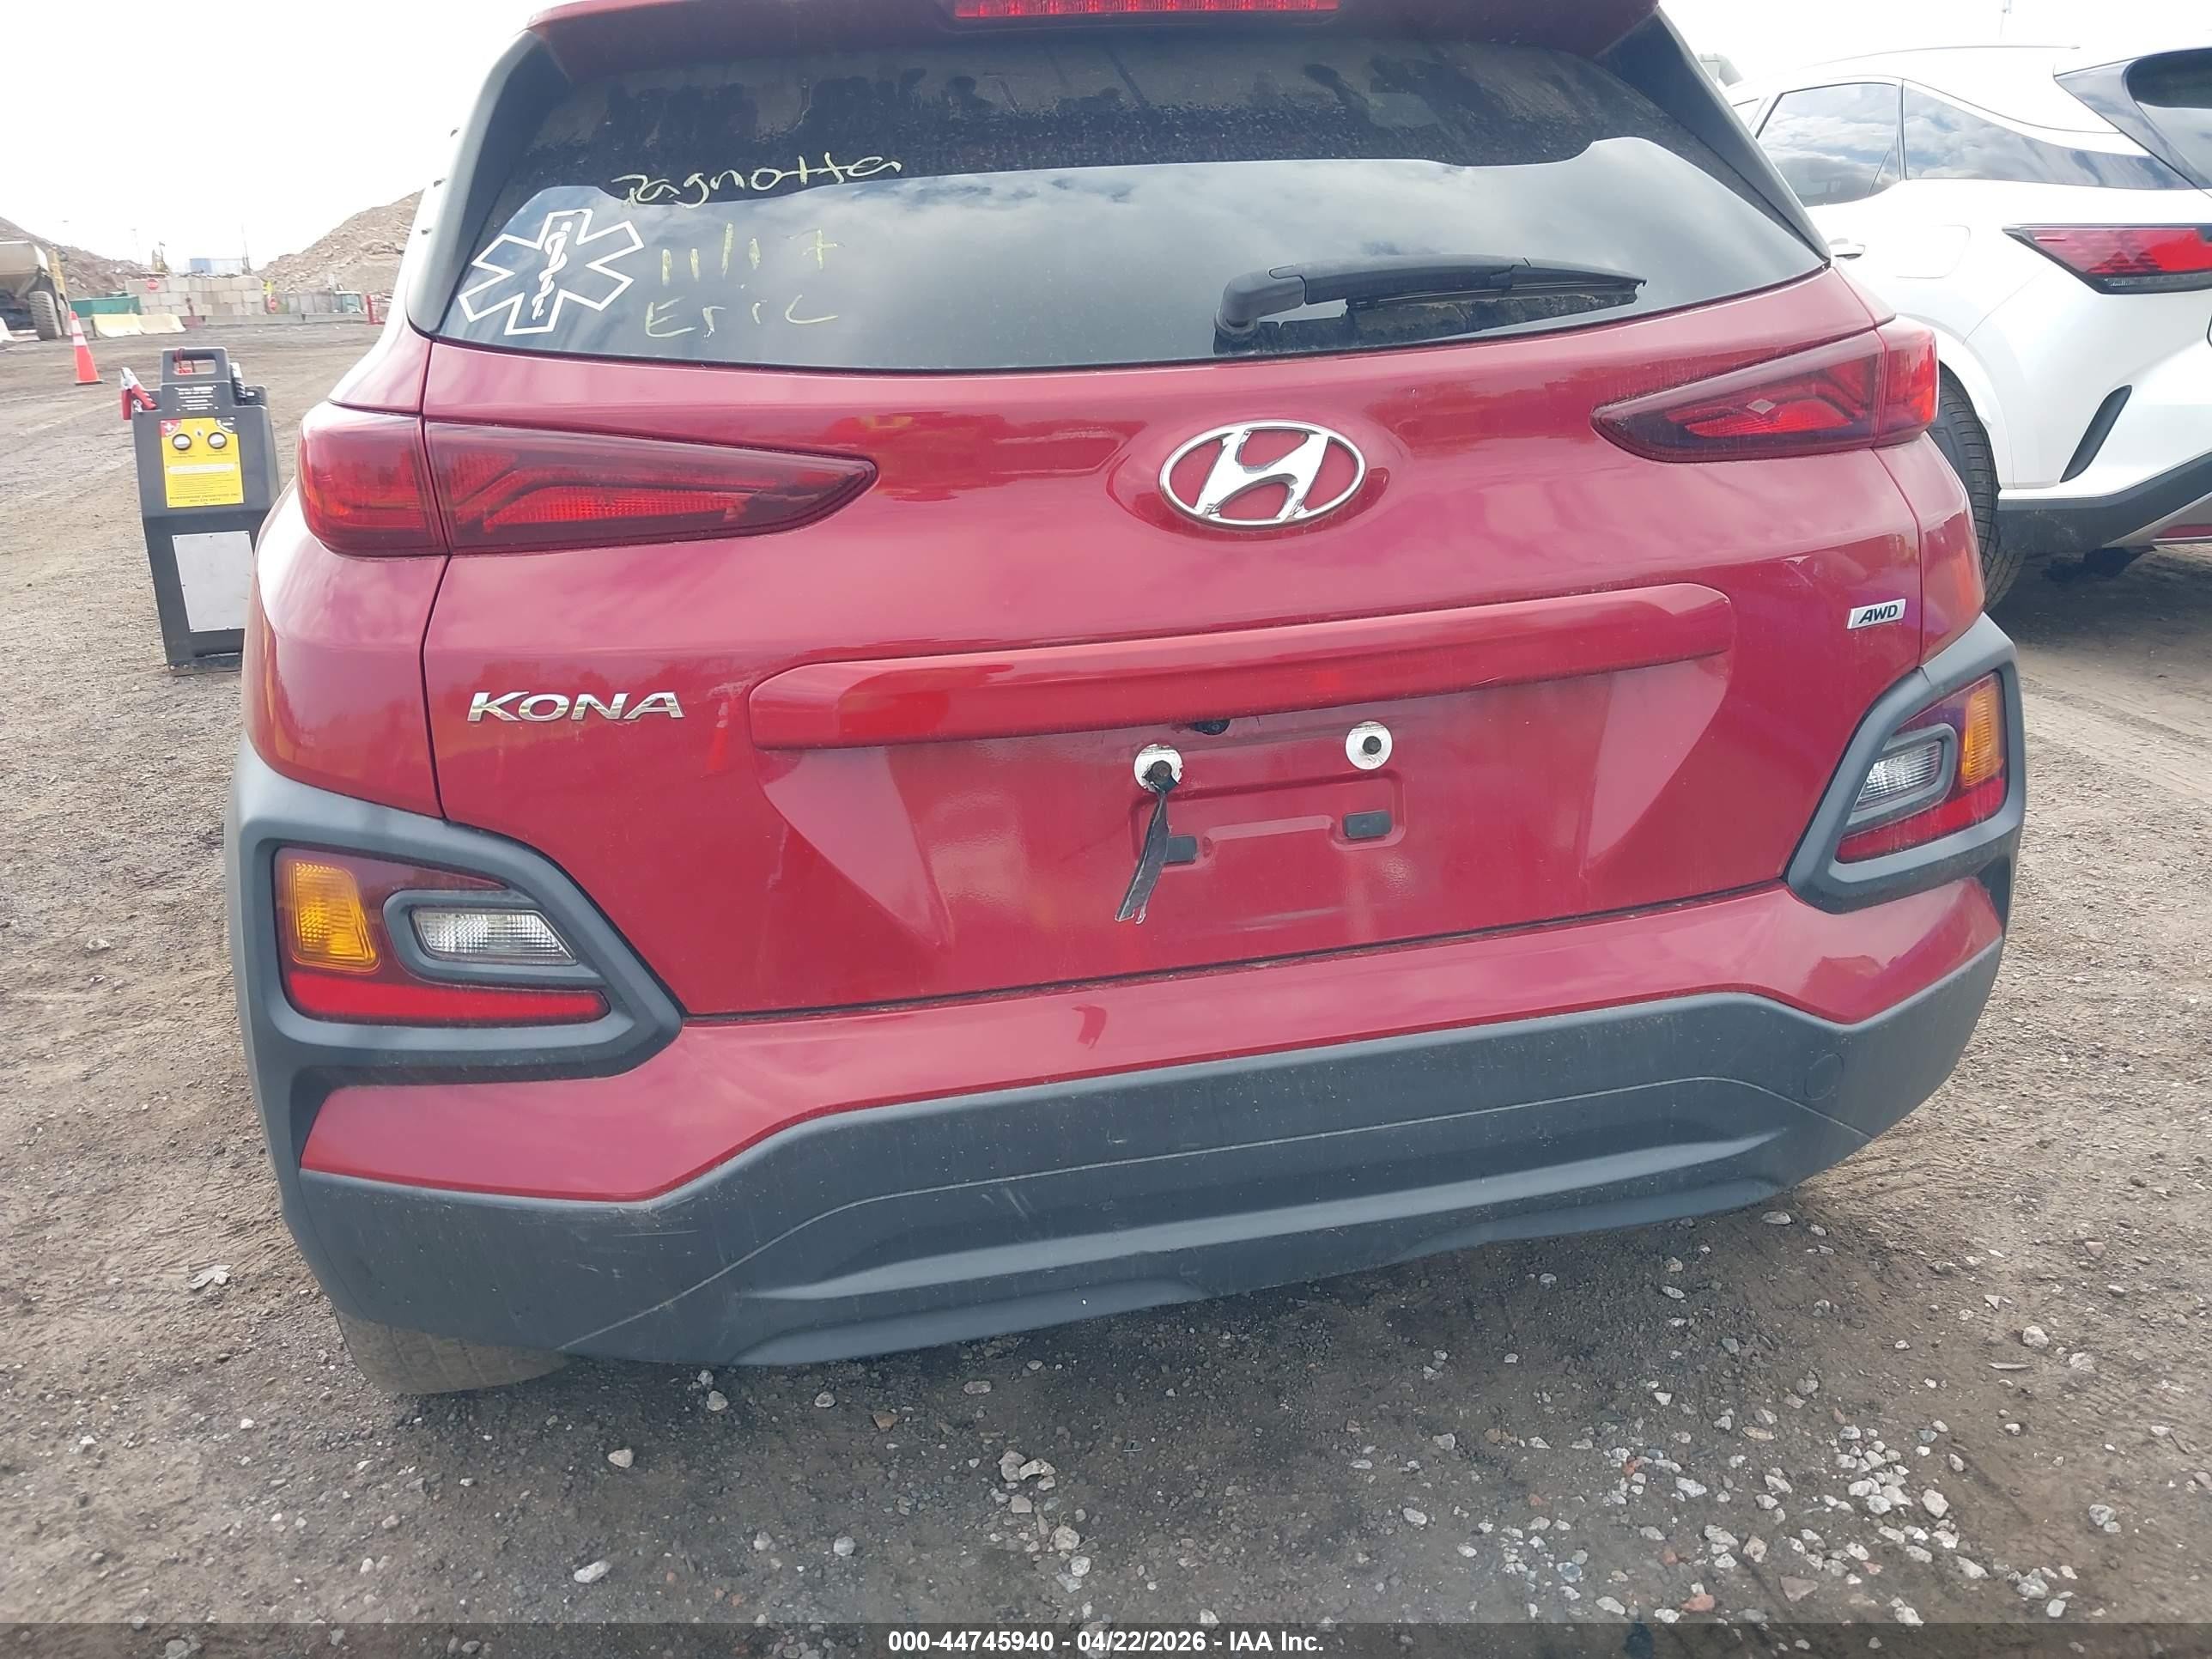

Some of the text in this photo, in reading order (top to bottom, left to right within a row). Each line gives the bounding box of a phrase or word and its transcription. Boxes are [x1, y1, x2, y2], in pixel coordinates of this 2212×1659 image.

[645, 295, 839, 338] Eric
[1858, 605, 1899, 624] AWD
[467, 691, 685, 722] KONA
